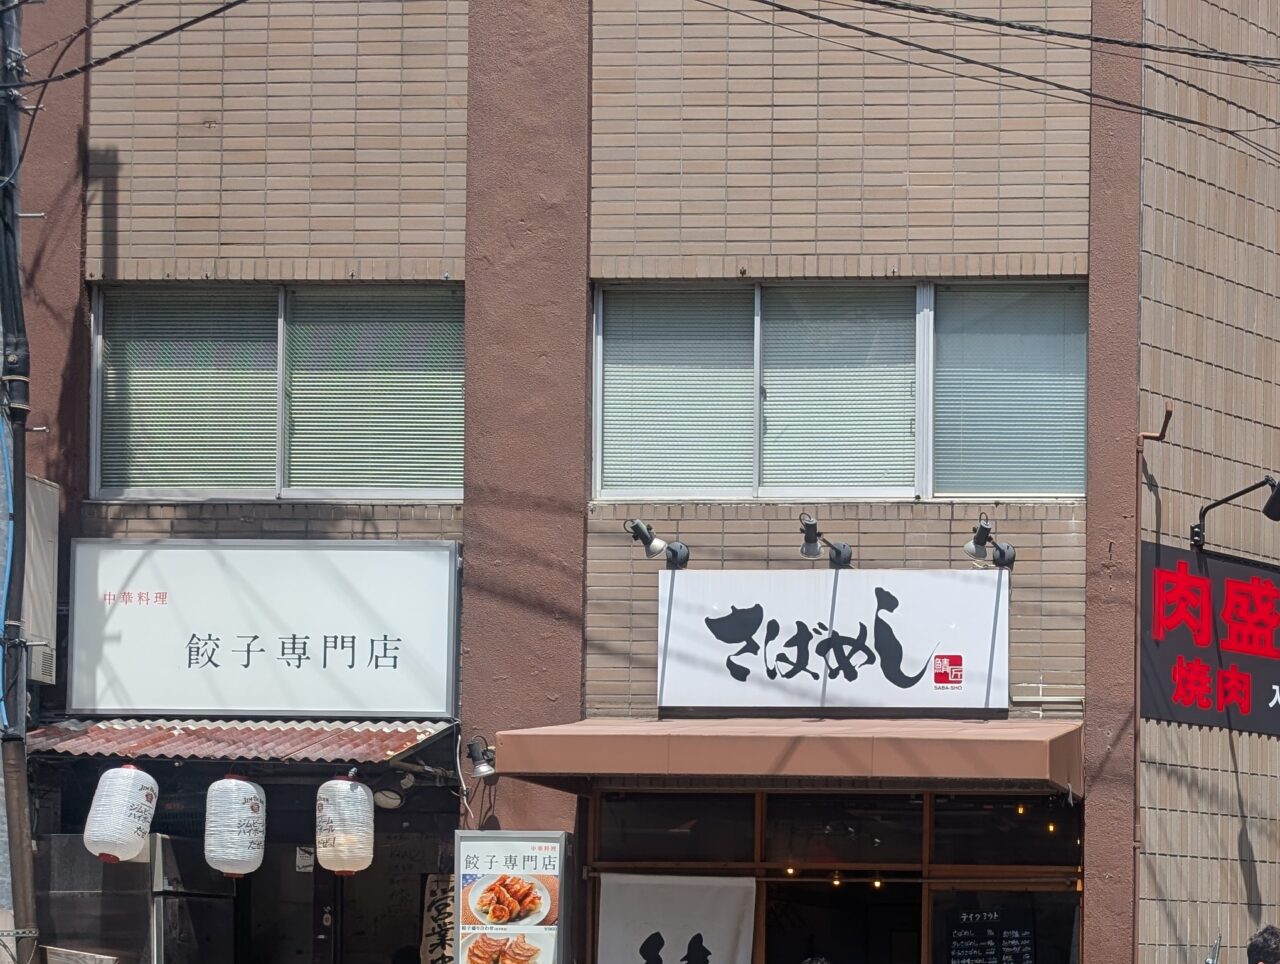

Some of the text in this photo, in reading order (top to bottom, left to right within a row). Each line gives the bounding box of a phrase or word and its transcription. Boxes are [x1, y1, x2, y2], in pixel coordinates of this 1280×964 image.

[103, 592, 168, 606] 中華料理
[704, 586, 941, 689] さばめし
[185, 633, 402, 670] 餃子専門店
[1171, 655, 1252, 716] 焼肉
[464, 854, 558, 871] 餃子専門店
[960, 911, 999, 922] テイクアウト
